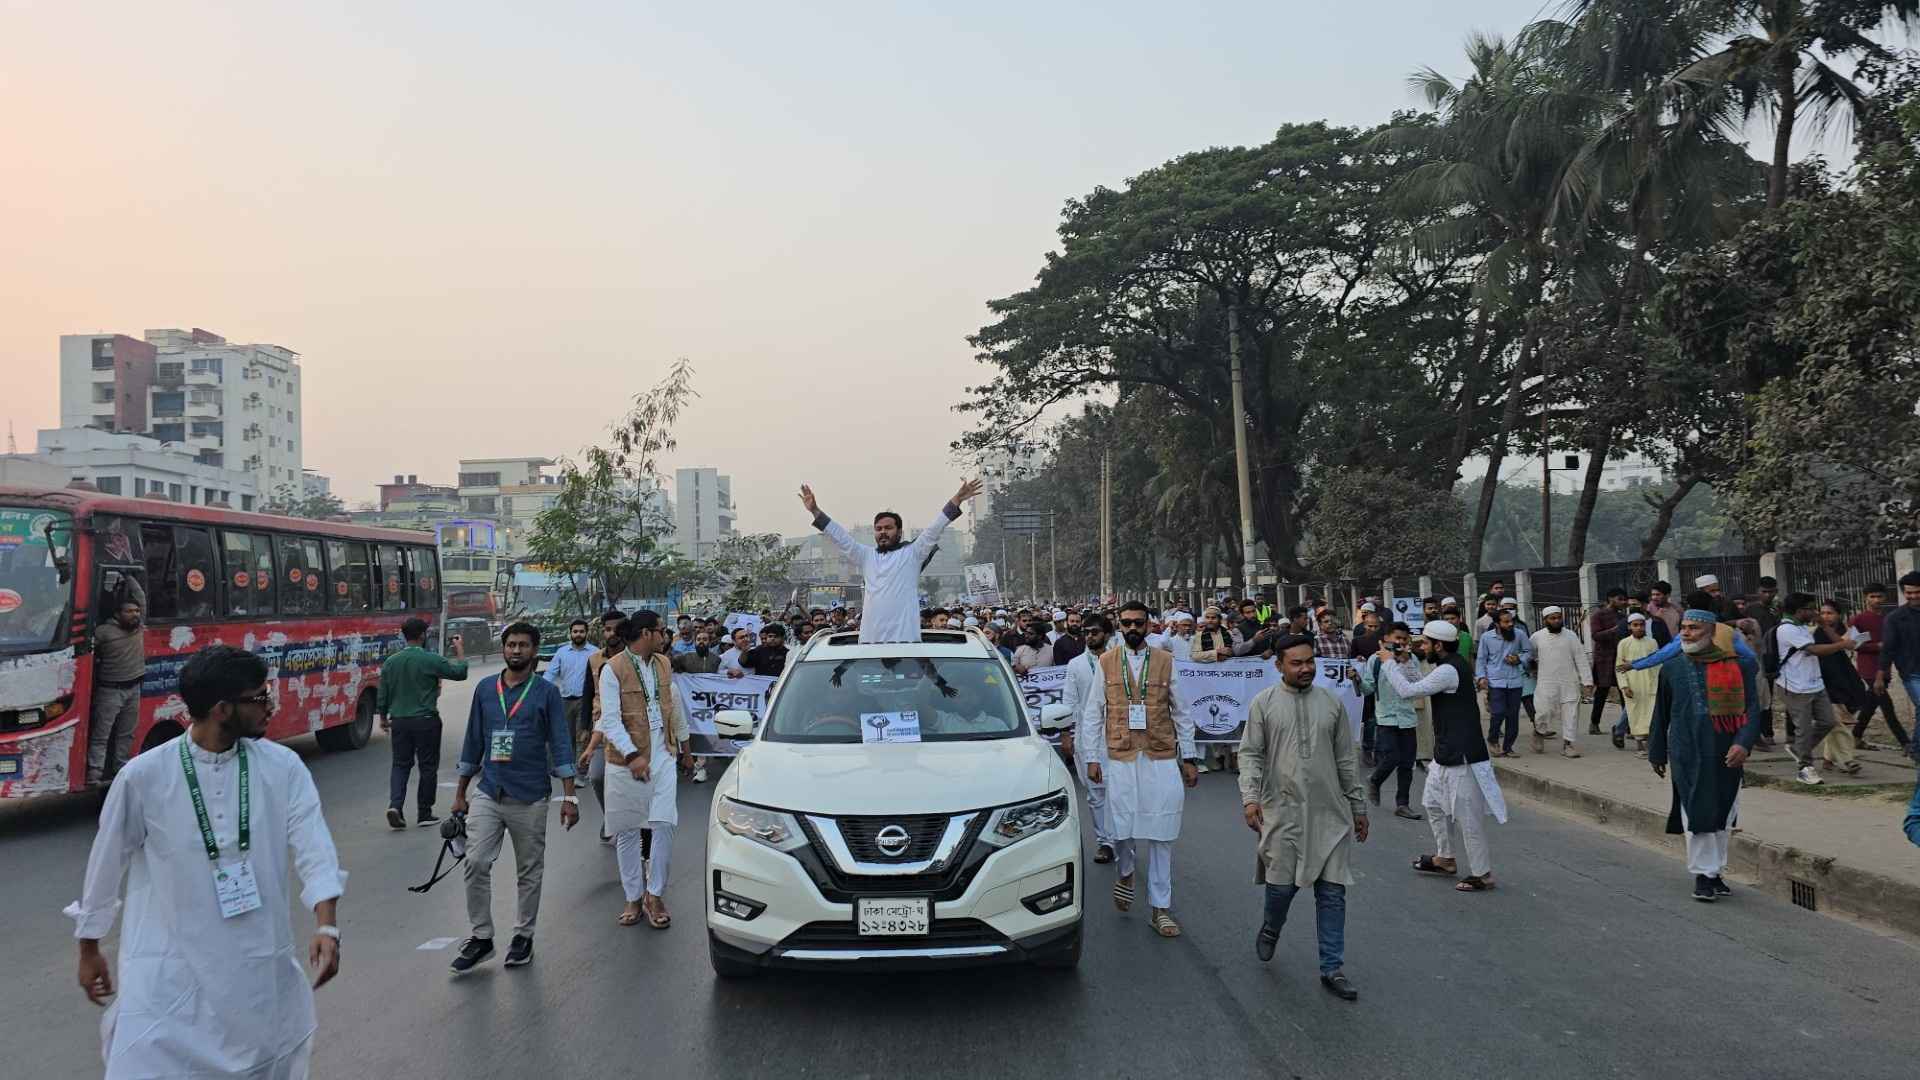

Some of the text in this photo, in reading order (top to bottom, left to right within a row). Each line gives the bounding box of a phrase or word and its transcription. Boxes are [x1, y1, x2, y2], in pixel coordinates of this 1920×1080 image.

[691, 690, 760, 710] শাপলা
[863, 906, 883, 916] ঢাকা
[861, 919, 927, 932] ১২-৪৩২৮
